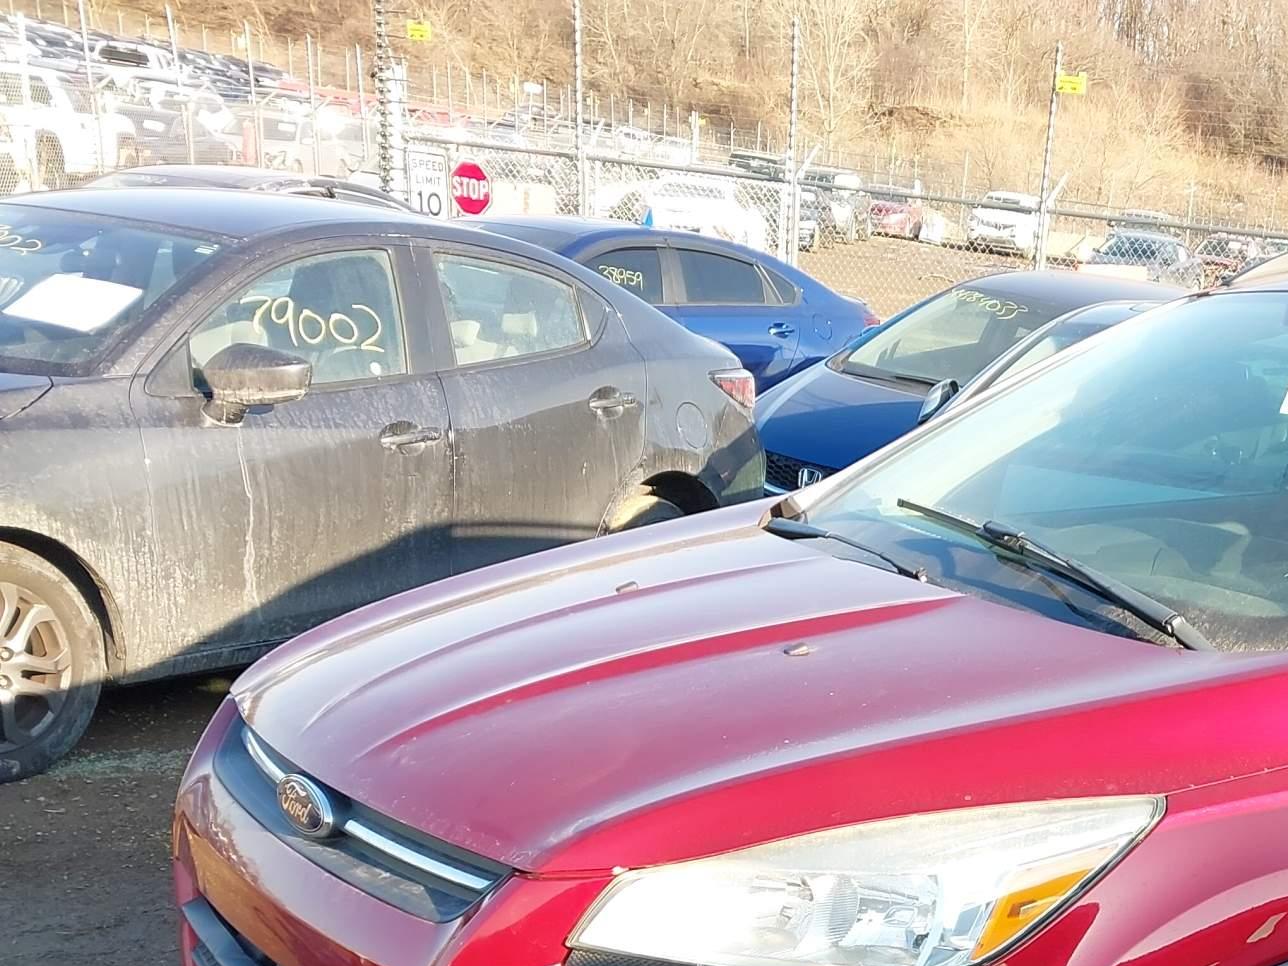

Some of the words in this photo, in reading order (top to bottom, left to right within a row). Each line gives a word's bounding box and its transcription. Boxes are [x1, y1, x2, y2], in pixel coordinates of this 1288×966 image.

[411, 158, 444, 172] SPEED
[416, 175, 441, 185] LIMIT
[452, 175, 489, 201] STOP
[417, 190, 442, 216] 10
[239, 295, 385, 353] 79002
[282, 781, 312, 824] Ford
